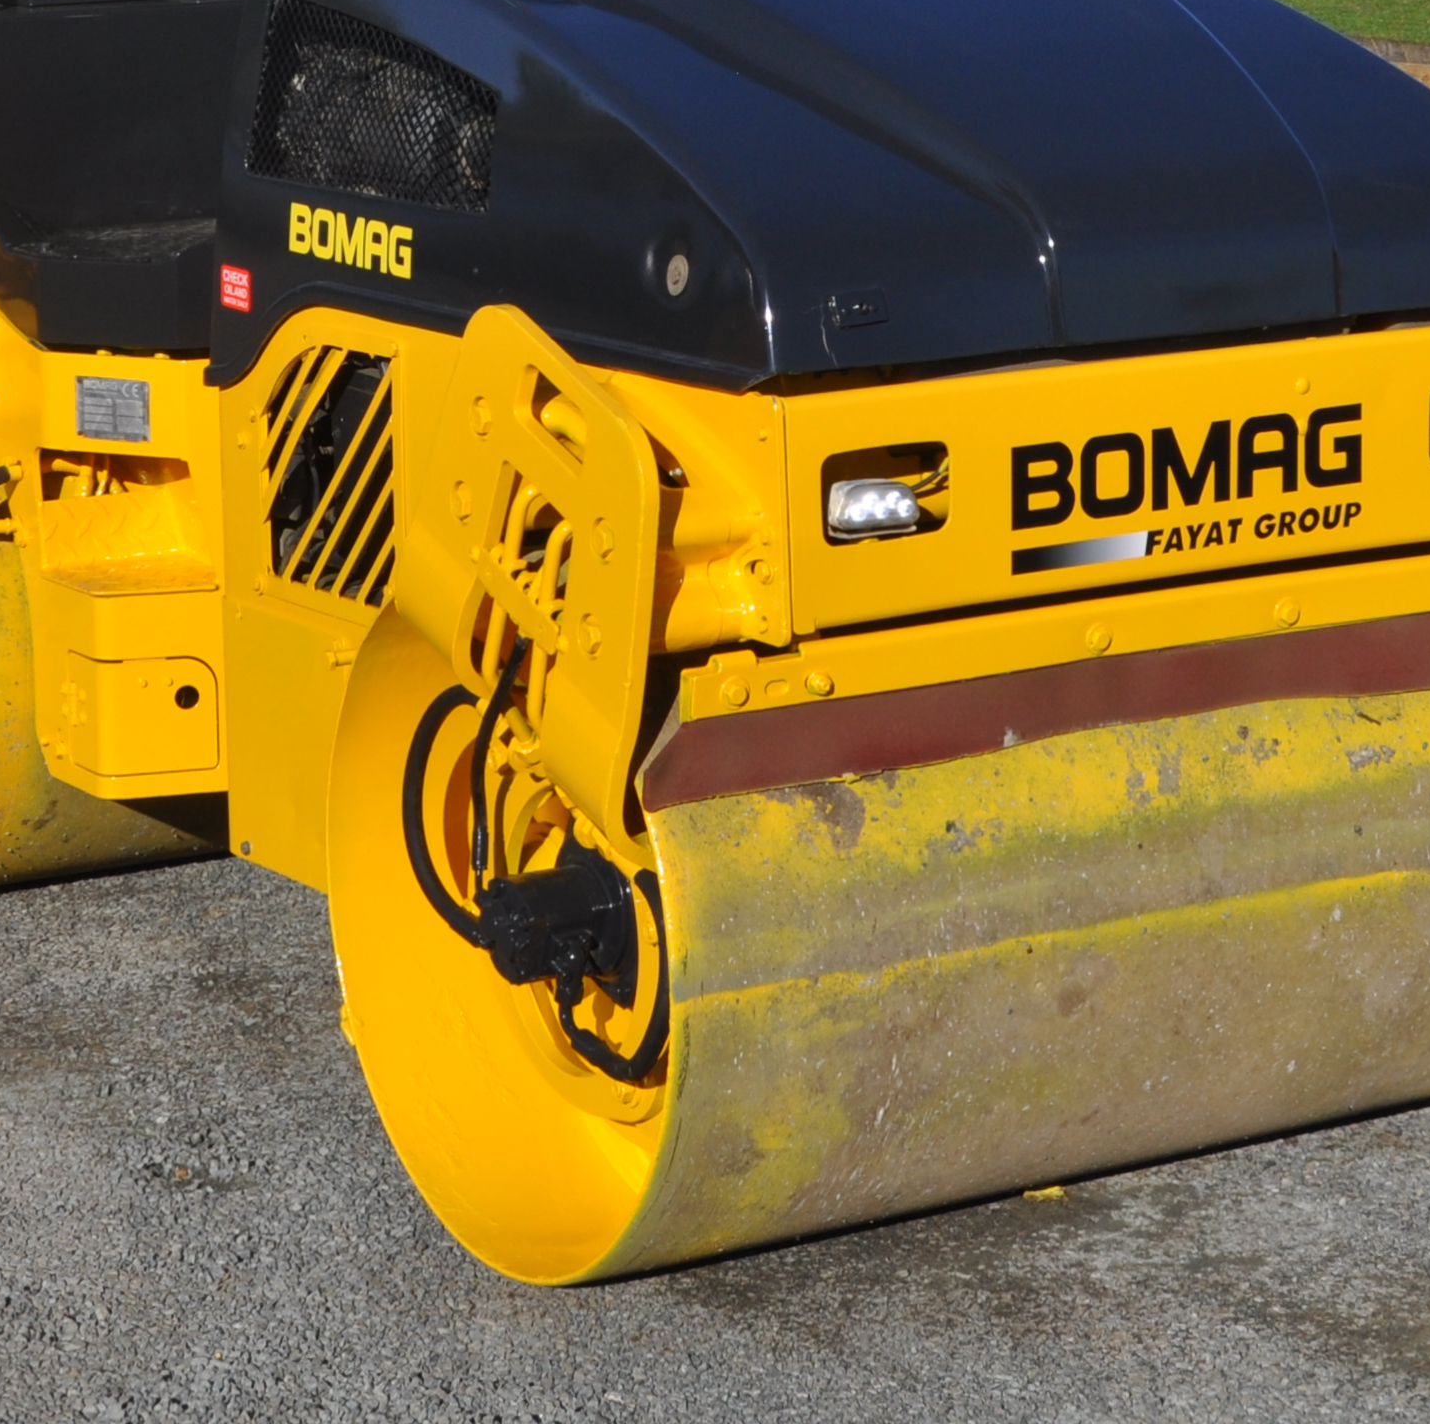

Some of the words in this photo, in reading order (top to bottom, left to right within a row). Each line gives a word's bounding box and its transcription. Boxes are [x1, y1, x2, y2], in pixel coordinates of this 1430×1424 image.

[289, 202, 413, 279] BOMAG
[223, 269, 248, 287] CHECK
[1011, 403, 1362, 531] BOMAG
[1145, 518, 1243, 556] FAYAT
[1254, 502, 1362, 538] GROUP
